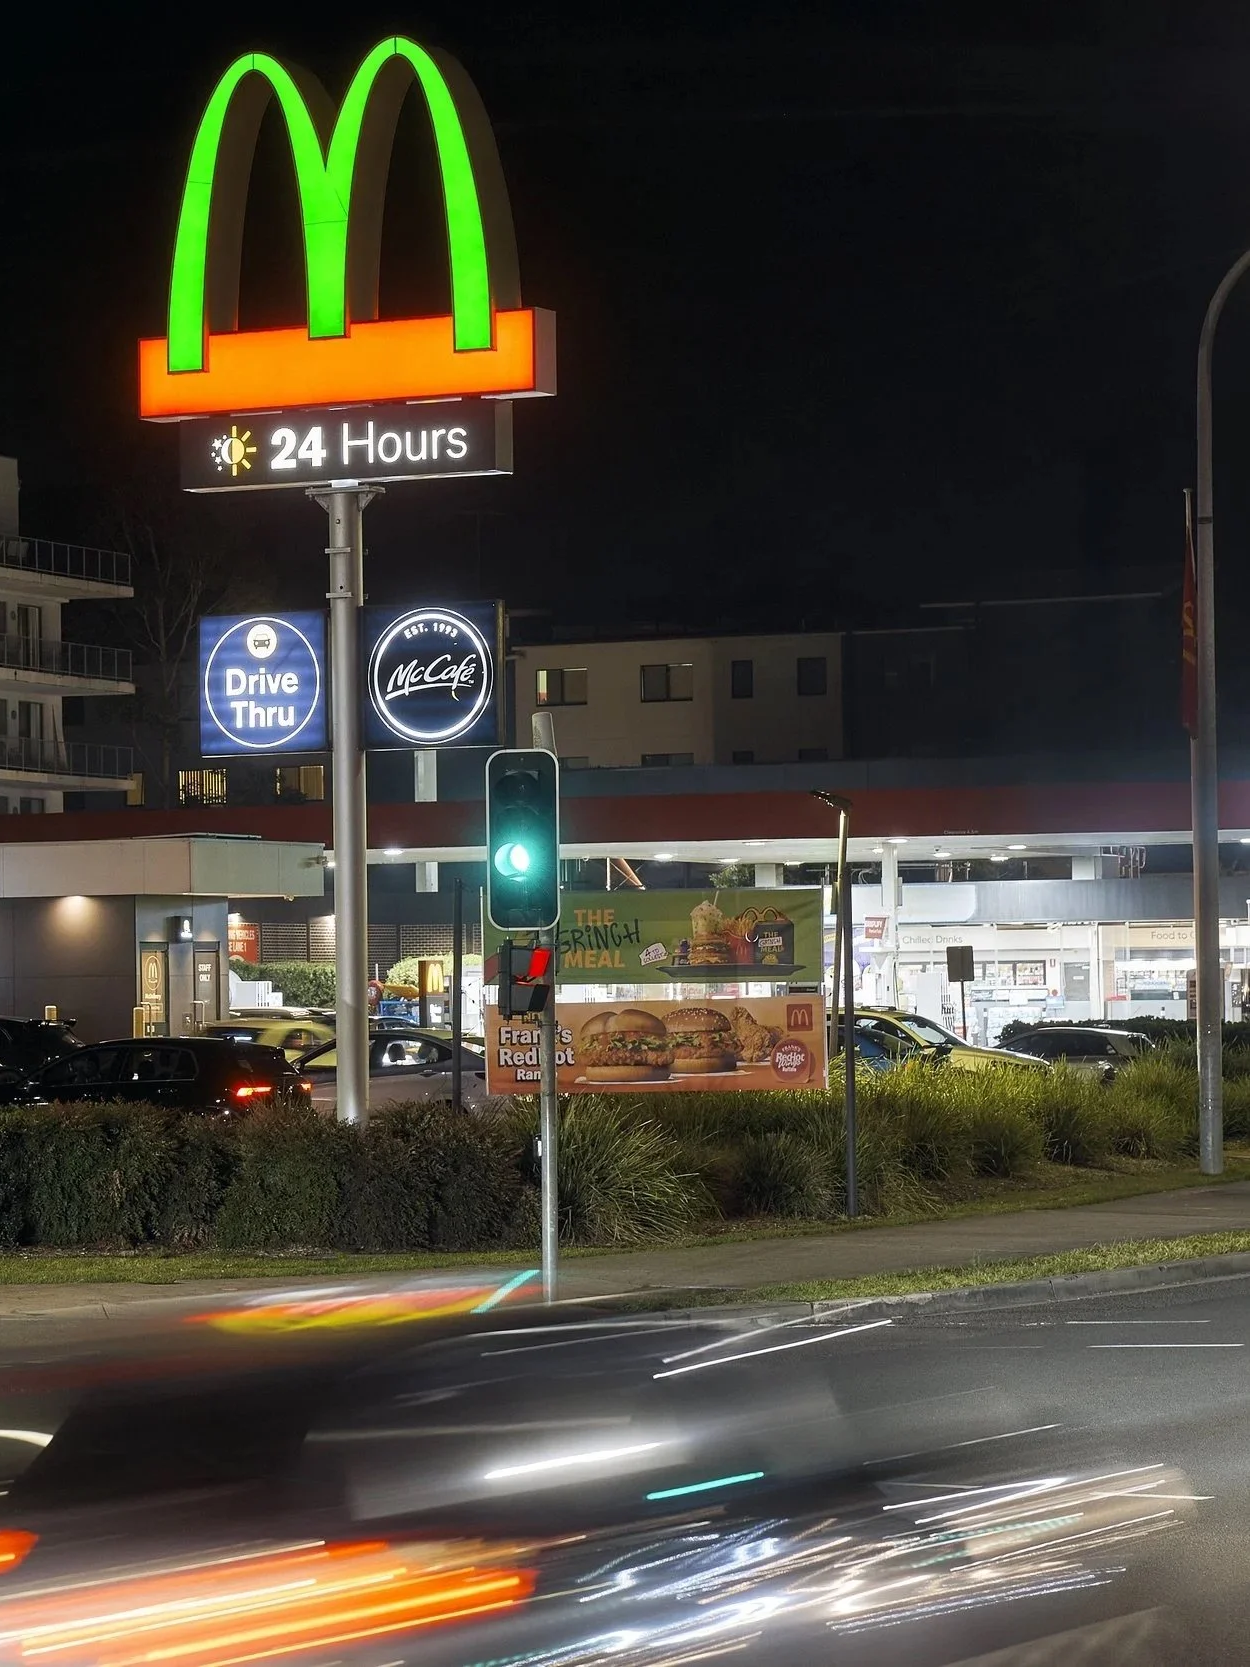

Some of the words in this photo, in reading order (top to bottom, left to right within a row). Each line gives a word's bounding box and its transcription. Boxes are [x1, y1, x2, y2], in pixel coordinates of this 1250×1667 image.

[269, 426, 327, 470] 24
[342, 420, 468, 466] Hours
[403, 623, 429, 641] EST.
[224, 668, 299, 697] Drive
[385, 653, 477, 701] McCafé
[230, 700, 296, 729] Thru
[573, 908, 616, 927] THE
[935, 935, 963, 944] Drinks
[1151, 930, 1175, 940] Food
[1177, 931, 1188, 940] to
[564, 949, 626, 969] MEAL
[499, 1025, 573, 1044] Fran's
[498, 1046, 576, 1066] Redot
